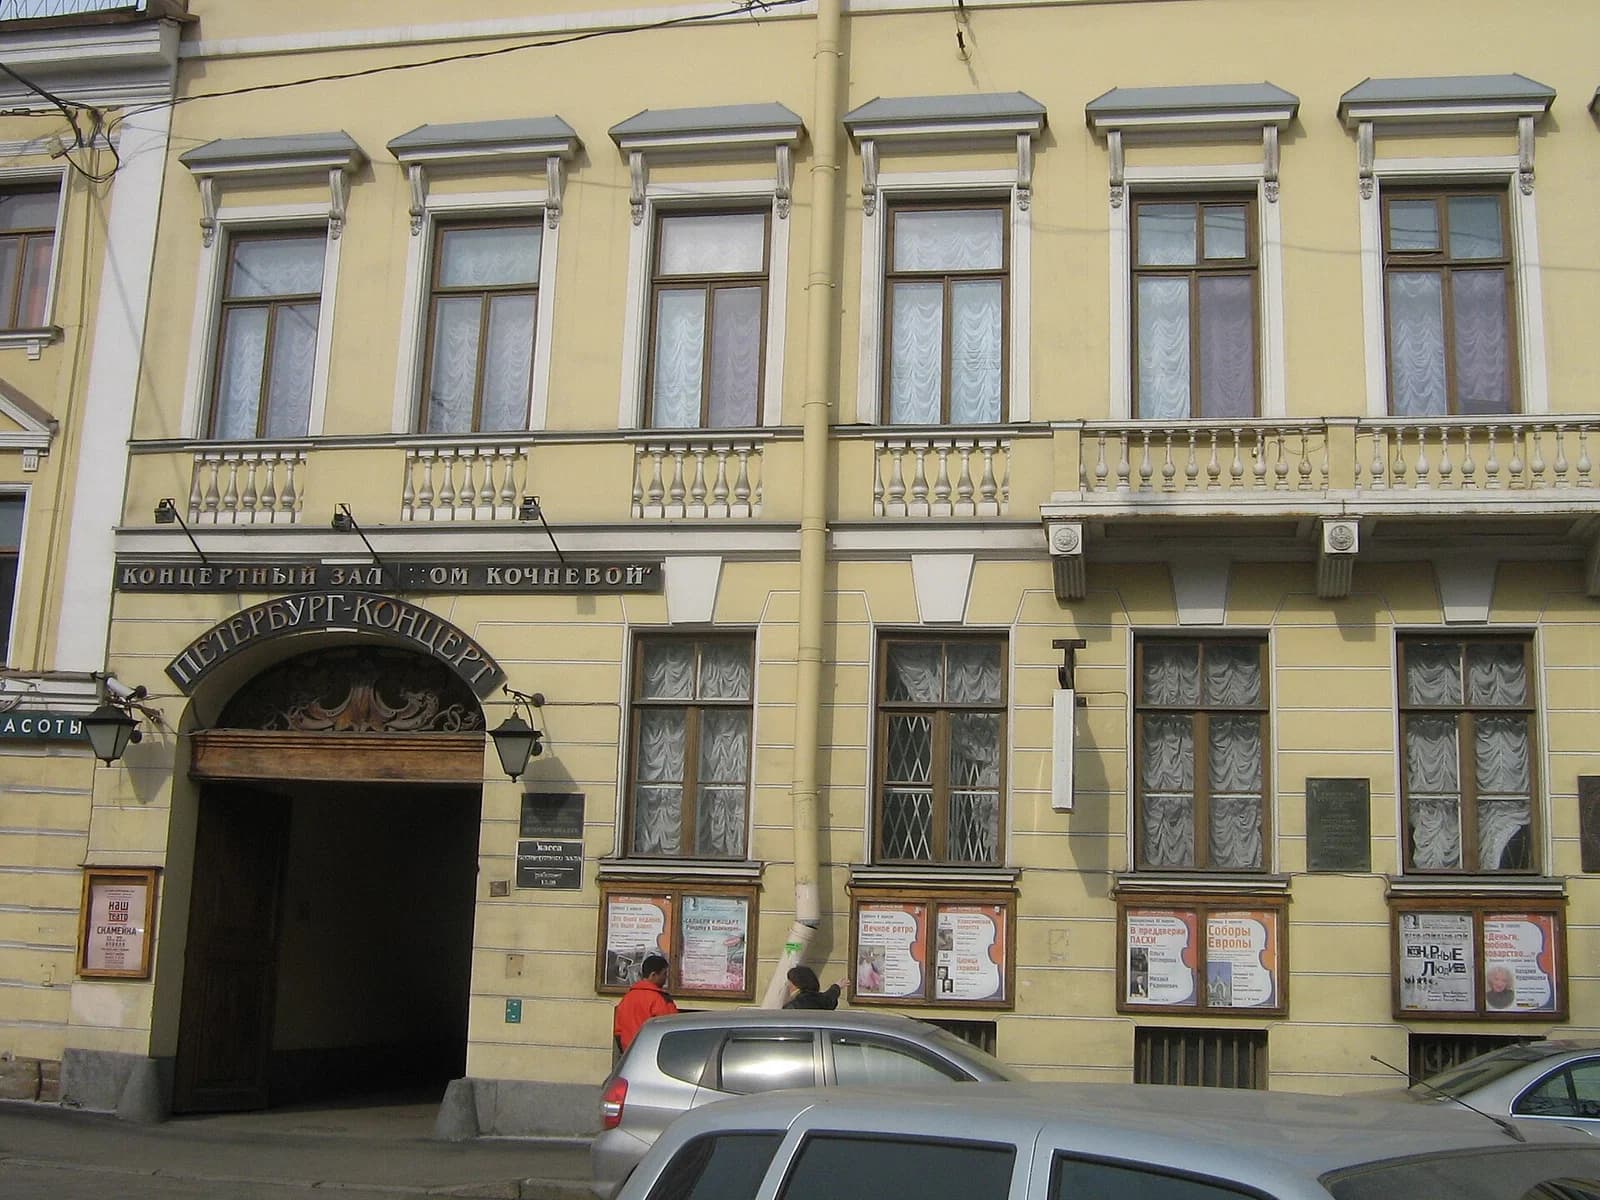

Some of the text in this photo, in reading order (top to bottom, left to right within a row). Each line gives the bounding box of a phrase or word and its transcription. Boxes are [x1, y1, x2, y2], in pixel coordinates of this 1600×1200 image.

[122, 564, 317, 588] КОНЦЕРТНЫЙ
[330, 567, 384, 585] ЗАЛ
[169, 594, 497, 685] ПЕТЕРБУРГ-КОНЦЕРТ
[3, 718, 82, 735] АСОТЫ
[1130, 926, 1136, 935] В
[1208, 925, 1251, 938] Соборы
[1208, 937, 1252, 950] Европы
